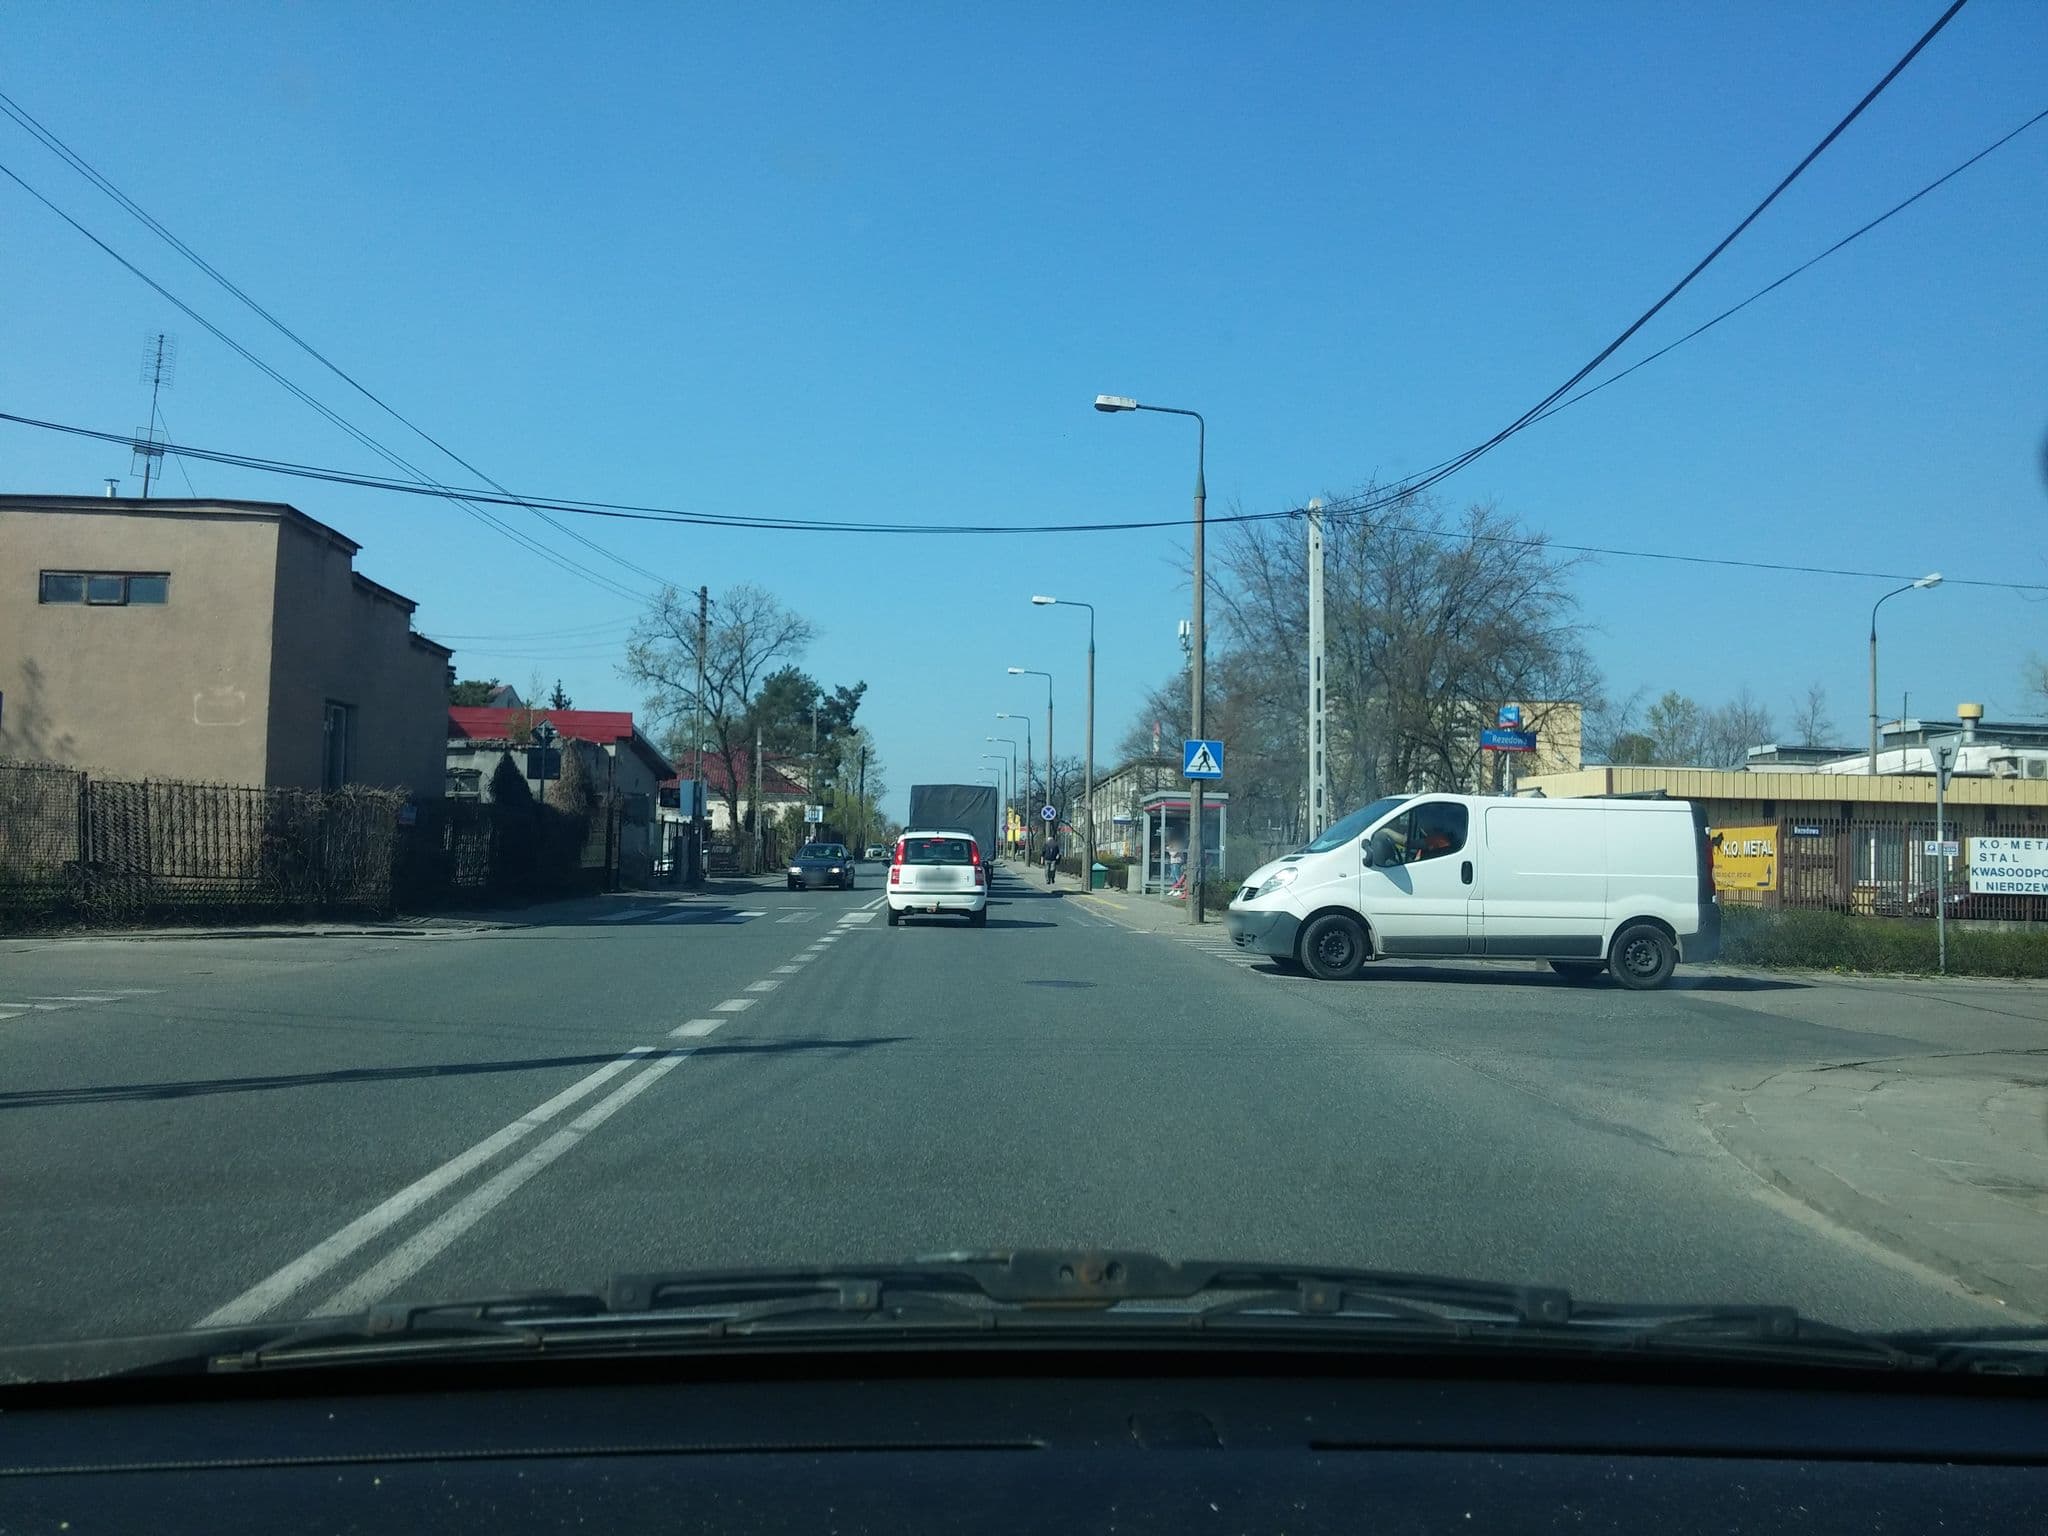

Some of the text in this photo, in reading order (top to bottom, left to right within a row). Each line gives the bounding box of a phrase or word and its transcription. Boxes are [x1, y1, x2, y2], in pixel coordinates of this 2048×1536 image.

[1723, 840, 1773, 857] K.O. METAL
[1979, 853, 2019, 863] STAL
